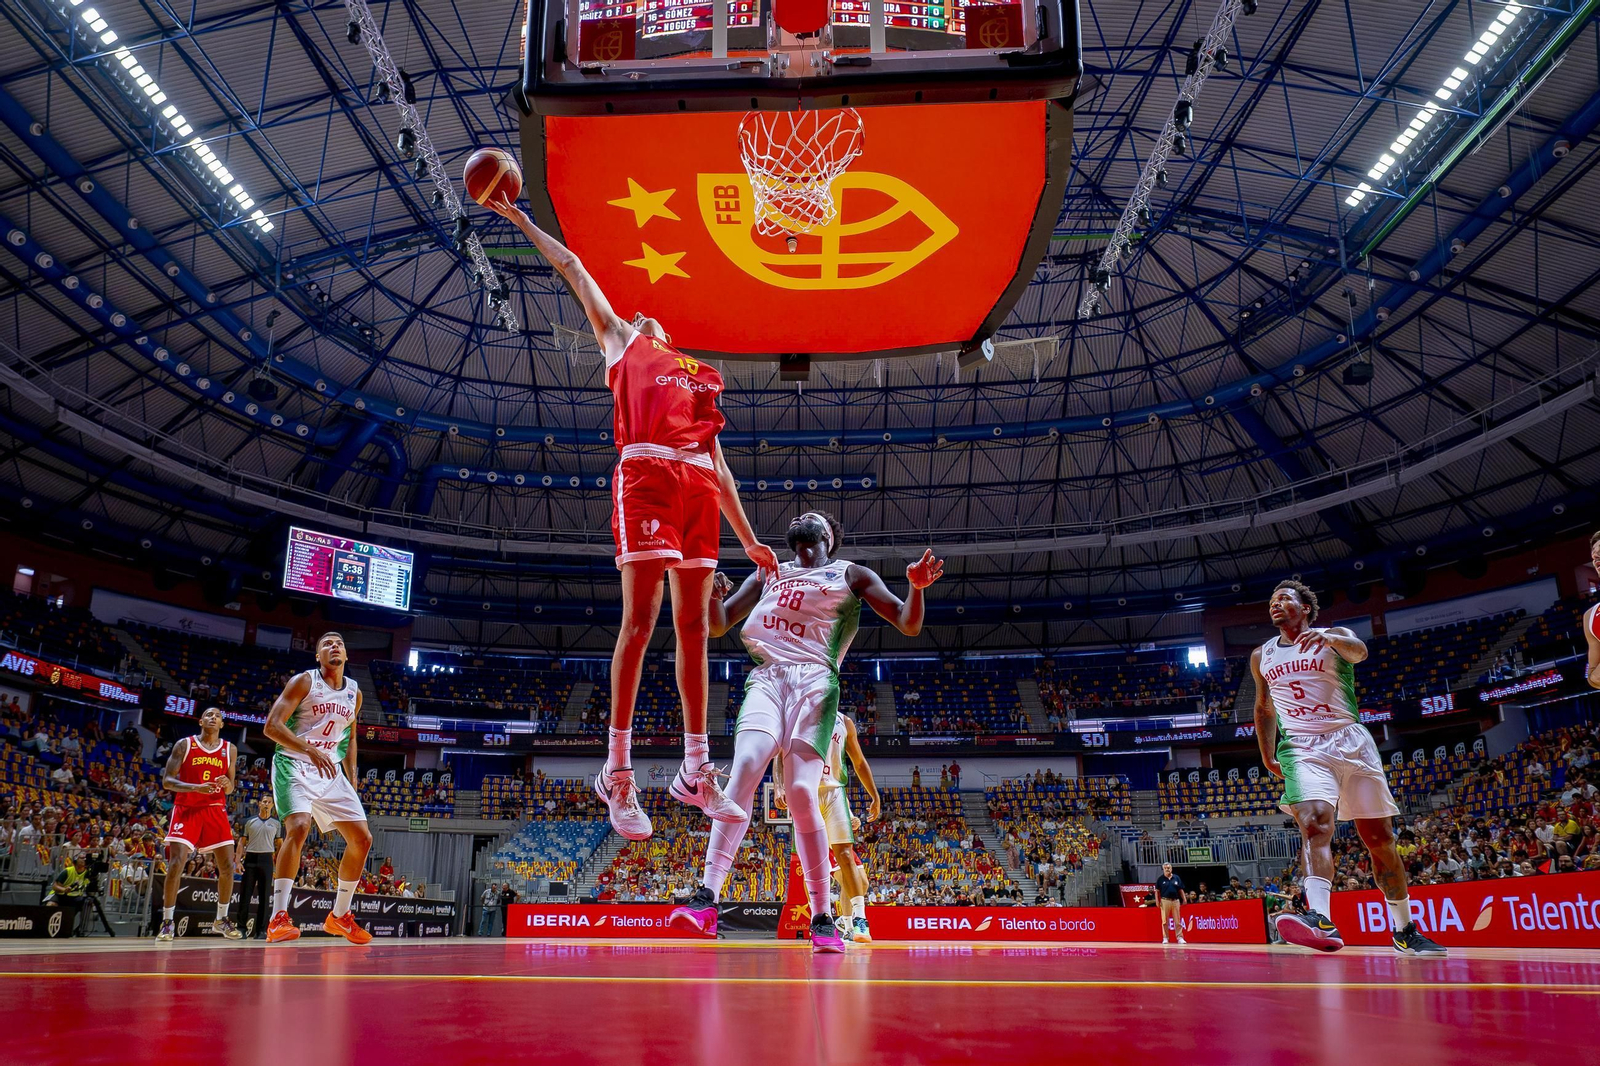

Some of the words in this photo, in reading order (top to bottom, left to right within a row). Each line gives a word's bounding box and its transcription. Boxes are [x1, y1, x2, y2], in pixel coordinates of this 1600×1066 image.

[841, 2, 854, 10] 09
[648, 14, 657, 22] 16
[841, 14, 849, 22] 11
[647, 26, 656, 34] 17
[713, 184, 742, 225] FEB
[674, 357, 699, 375] 15
[340, 540, 346, 548] 7
[358, 544, 369, 552] 10
[342, 563, 362, 574] 5:38
[776, 588, 805, 611] 88
[763, 615, 806, 638] una
[0, 653, 35, 676] AVIS
[1265, 658, 1326, 684] PORTUGAL
[1288, 680, 1305, 700] 5
[164, 695, 196, 716] SDI
[1421, 694, 1454, 715] SDI
[312, 702, 353, 722] PORTUGAL
[322, 720, 335, 736] 0
[483, 734, 510, 746] SDI
[1082, 733, 1109, 747] SDI
[192, 756, 223, 768] ESPAÑA
[202, 770, 211, 781] 6
[192, 888, 219, 903] endes
[743, 907, 778, 916] endesa
[527, 914, 590, 926] IBERIA
[610, 916, 653, 927] Talento
[655, 918, 662, 927] a
[908, 918, 972, 929] IBERIA
[998, 918, 1046, 930] Talento
[1049, 920, 1056, 930] a
[1060, 918, 1095, 931] bordo
[1195, 916, 1216, 929] Talento
[1221, 914, 1238, 929] bordo
